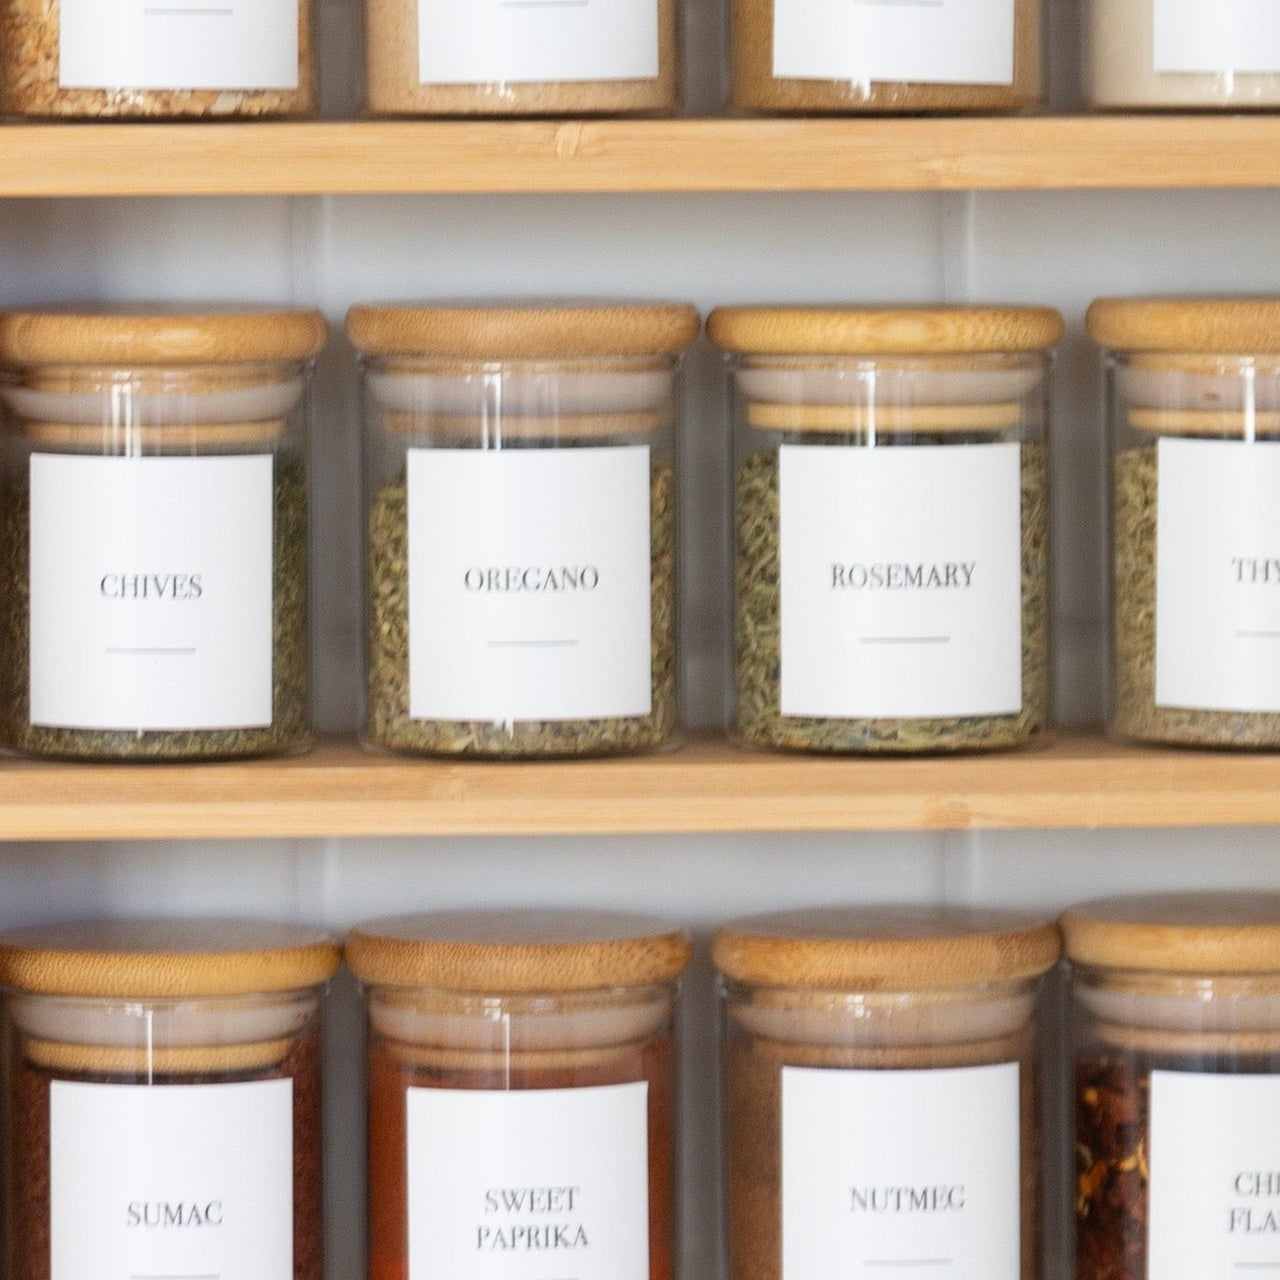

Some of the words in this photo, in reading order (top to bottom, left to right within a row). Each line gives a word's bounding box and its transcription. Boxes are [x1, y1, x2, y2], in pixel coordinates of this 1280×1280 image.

[100, 575, 203, 599] CHIVES
[464, 567, 599, 591] OREGANO
[831, 561, 976, 589] ROSEMARY
[485, 1186, 580, 1213] SWEET
[851, 1186, 965, 1211] NUTMEG
[127, 1202, 223, 1226] SUMAC
[477, 1224, 589, 1249] PAPRIKA
